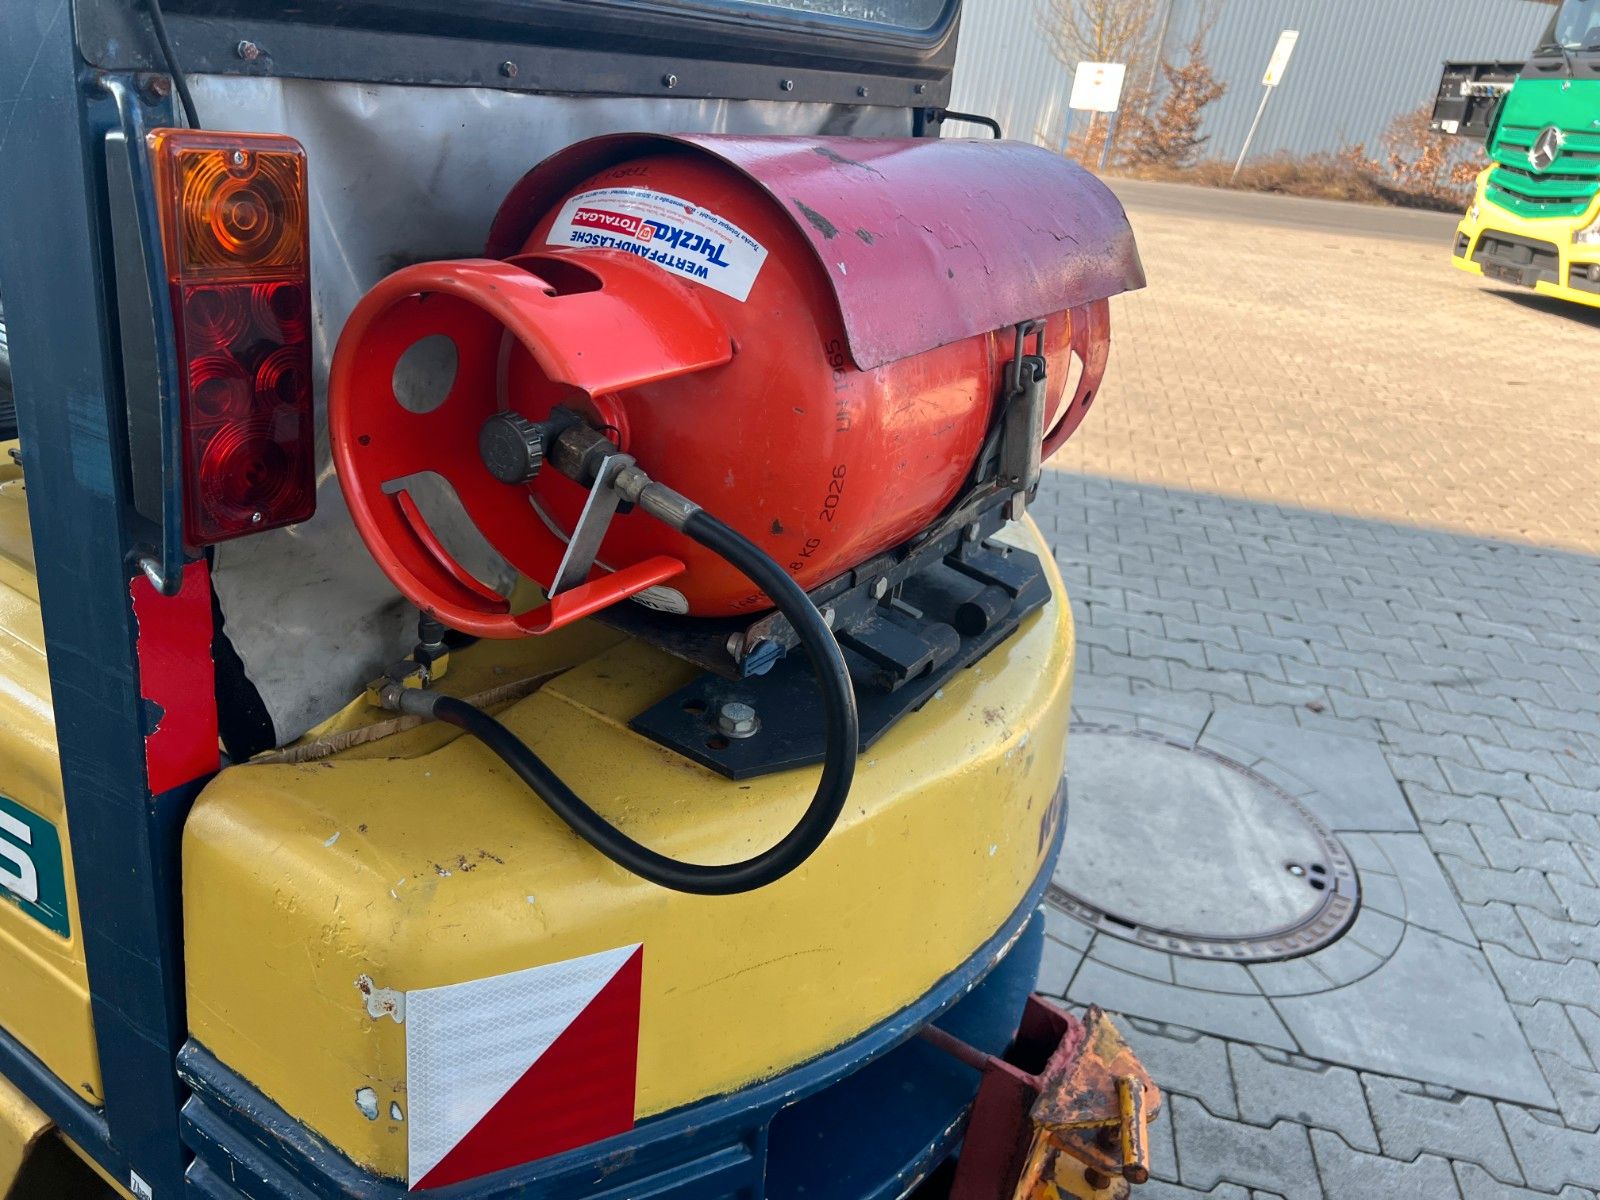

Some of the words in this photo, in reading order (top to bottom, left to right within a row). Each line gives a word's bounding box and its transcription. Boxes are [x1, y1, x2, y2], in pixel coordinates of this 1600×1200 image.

[574, 210, 637, 232] TOTALGAZ
[643, 219, 730, 268] Tyczka
[570, 230, 709, 279] WERTPFANDFLASCHE
[825, 339, 849, 392] 1965
[819, 463, 847, 522] 2026
[799, 537, 821, 560] KG
